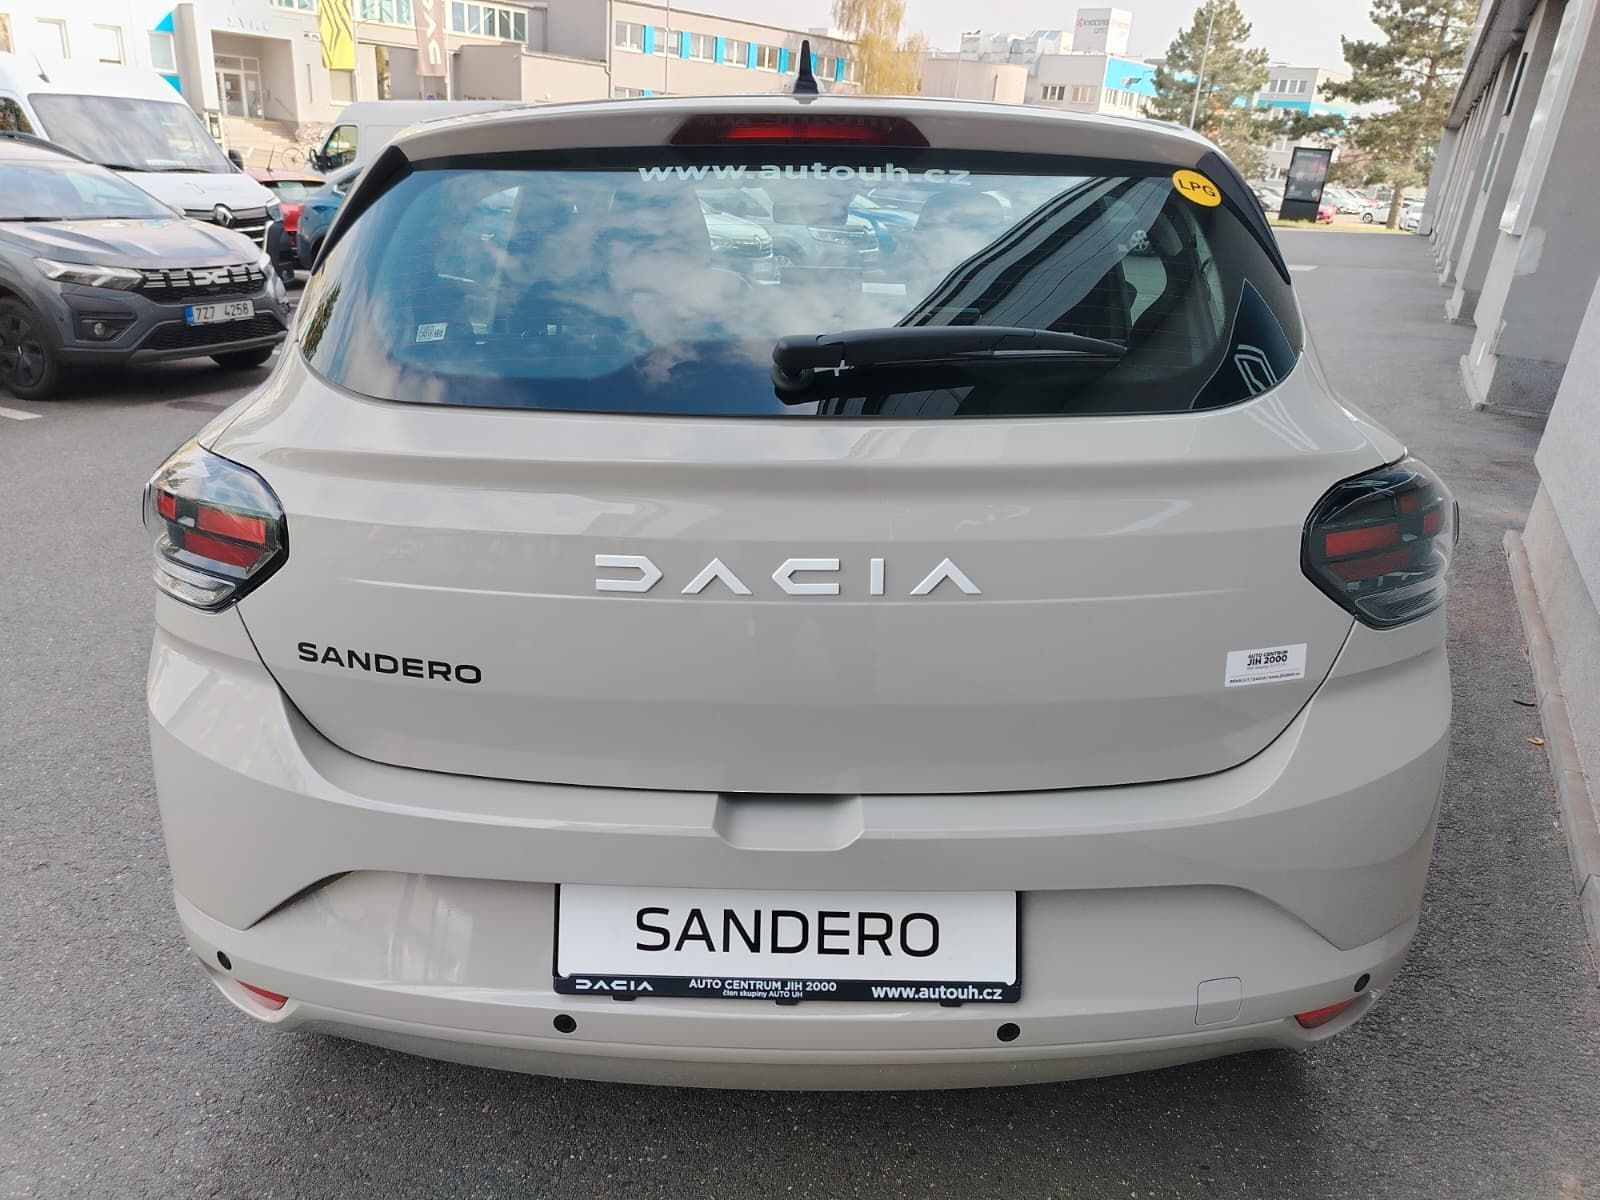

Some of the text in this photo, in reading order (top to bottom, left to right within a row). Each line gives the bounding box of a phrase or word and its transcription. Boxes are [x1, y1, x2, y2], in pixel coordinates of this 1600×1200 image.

[638, 161, 972, 186] www.autouh.cz
[1178, 179, 1216, 197] LPG
[195, 303, 249, 320] 7Z7 4258
[595, 554, 982, 595] DACIA
[298, 641, 482, 684] SANDERO
[1247, 655, 1288, 666] JIH 2000
[635, 906, 940, 957] SANDERO
[575, 979, 654, 991] DACIA
[689, 978, 837, 991] AUTO CENTRUM JIH 2000
[871, 985, 1003, 1000] www.autouh.cz
[740, 990, 767, 998] skupiny
